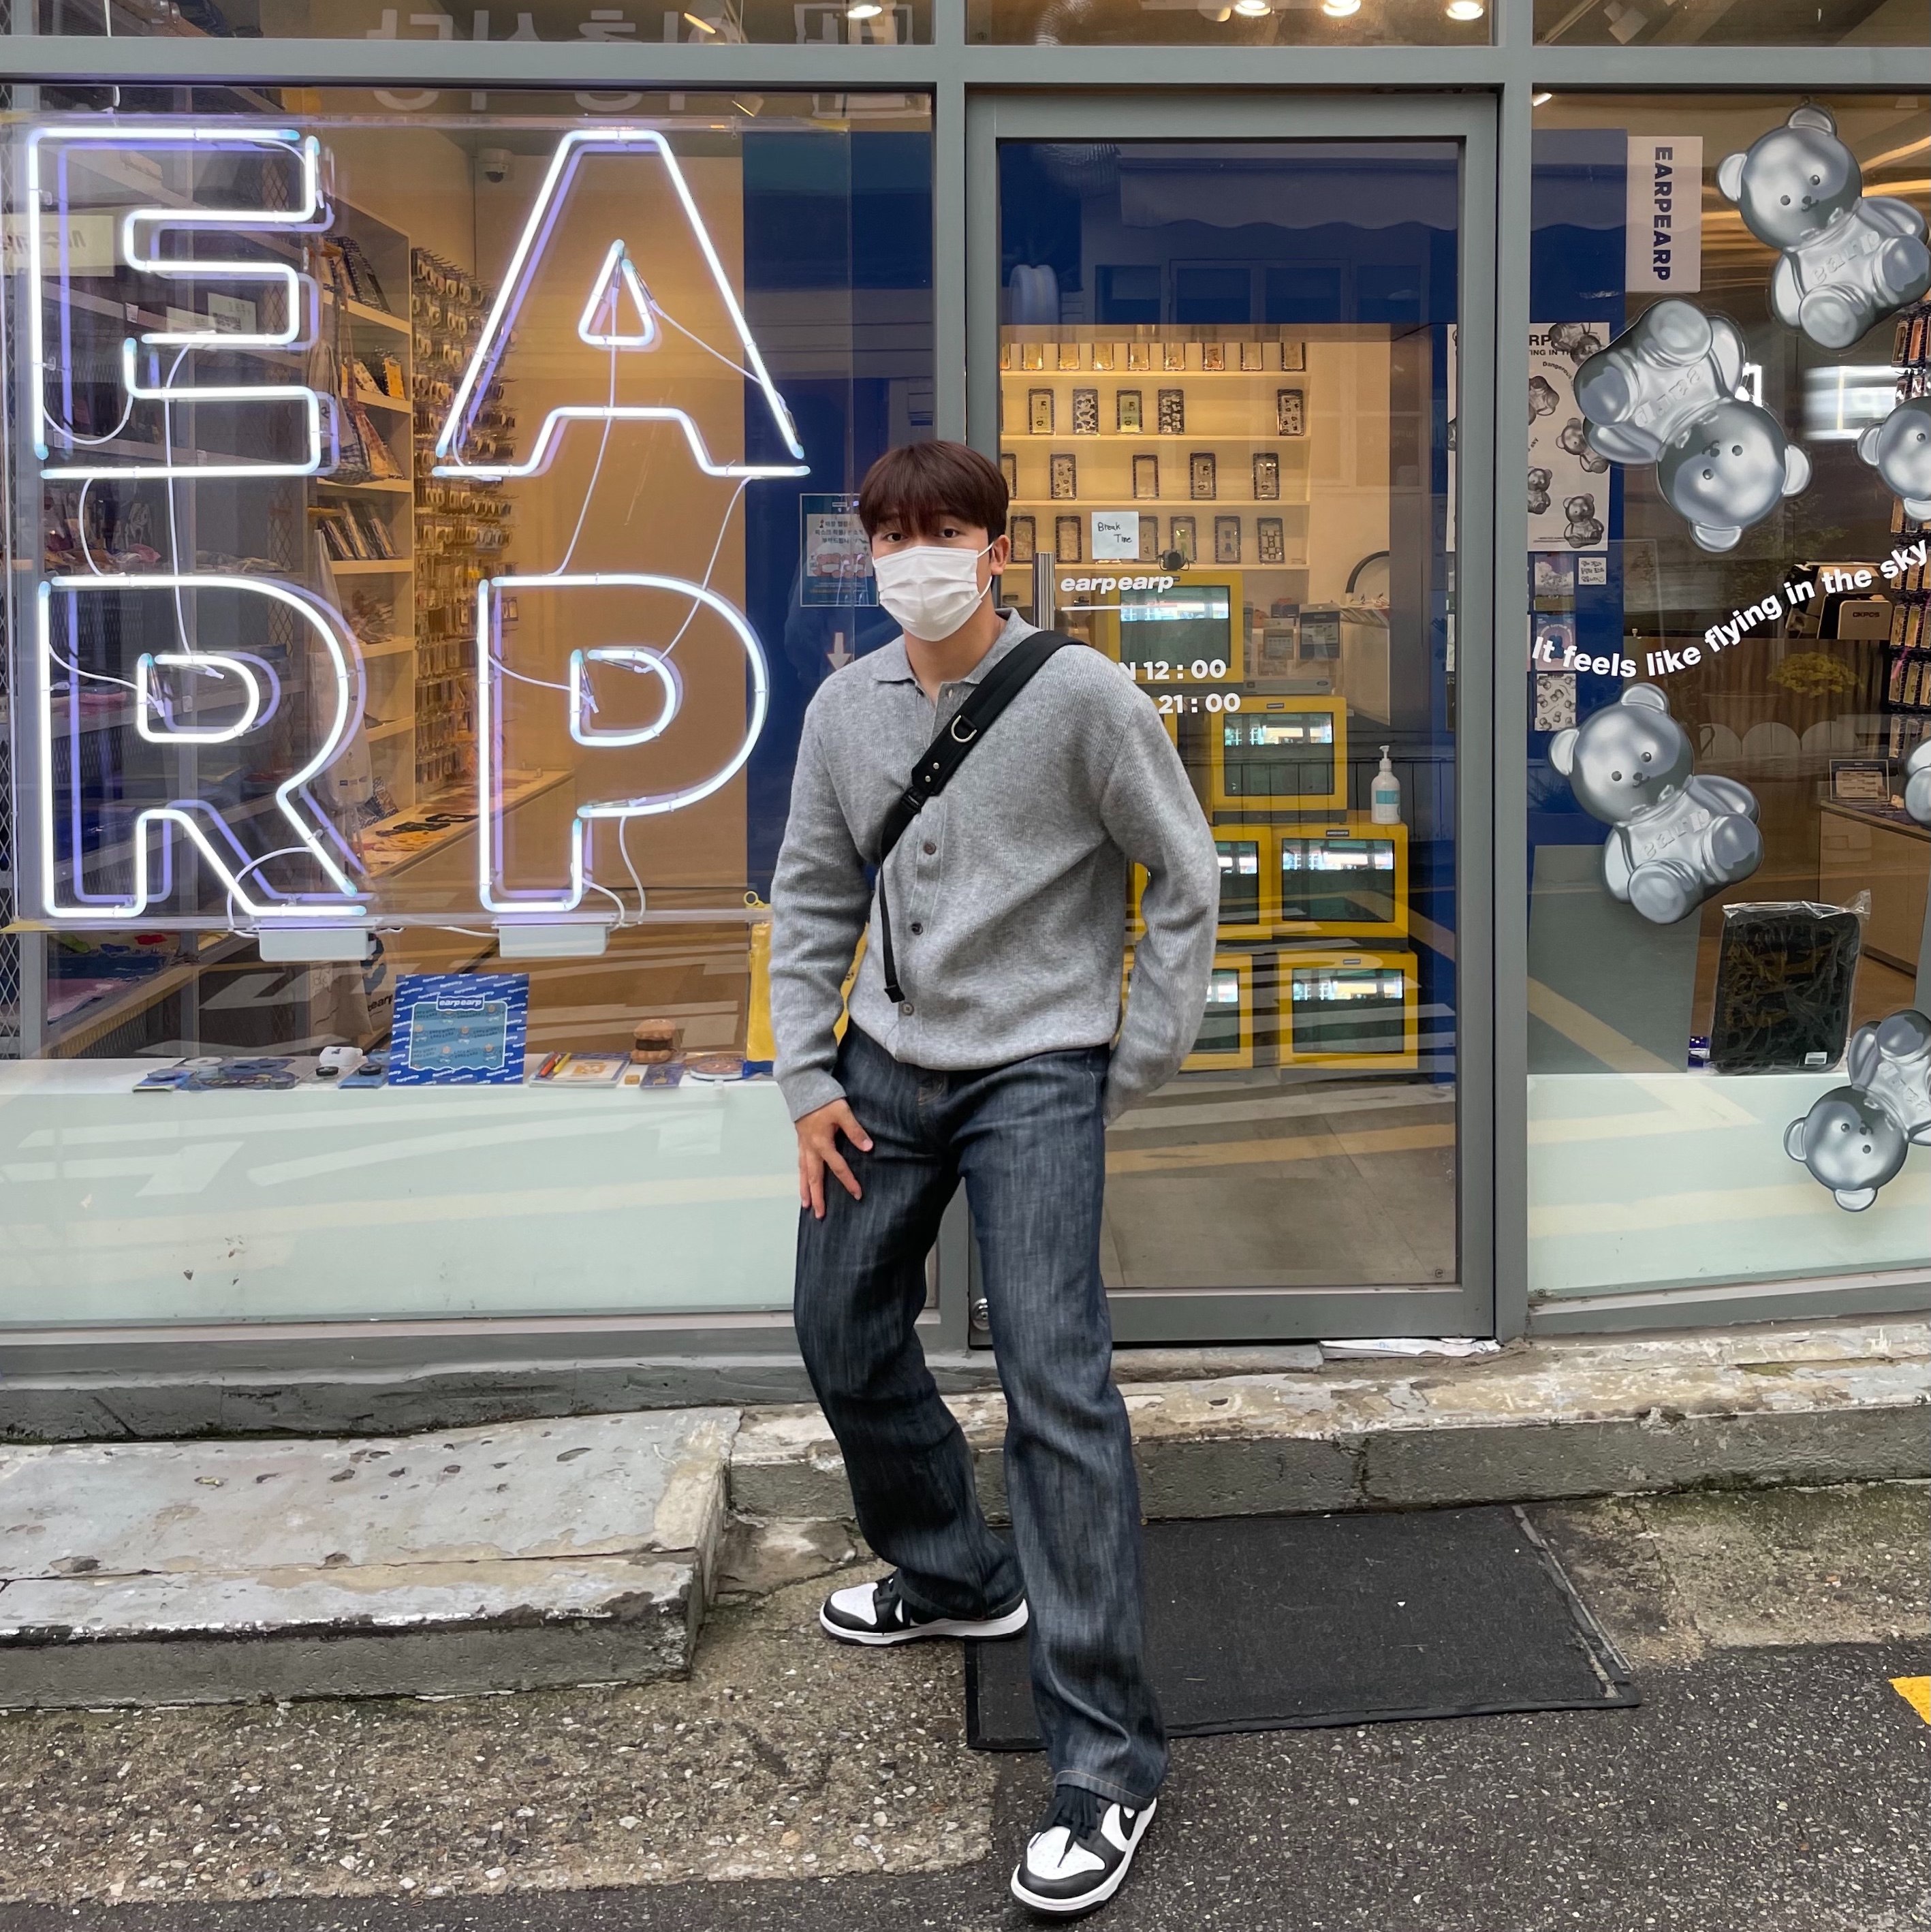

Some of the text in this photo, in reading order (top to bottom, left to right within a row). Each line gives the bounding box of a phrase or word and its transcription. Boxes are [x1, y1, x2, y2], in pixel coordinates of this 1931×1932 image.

[1652, 146, 1674, 281] EARPEARP
[1097, 521, 1121, 532] Break
[1060, 576, 1174, 595] earpearp
[1531, 540, 1927, 677] It feels like flying in the sky
[439, 997, 483, 1008] earpearp
